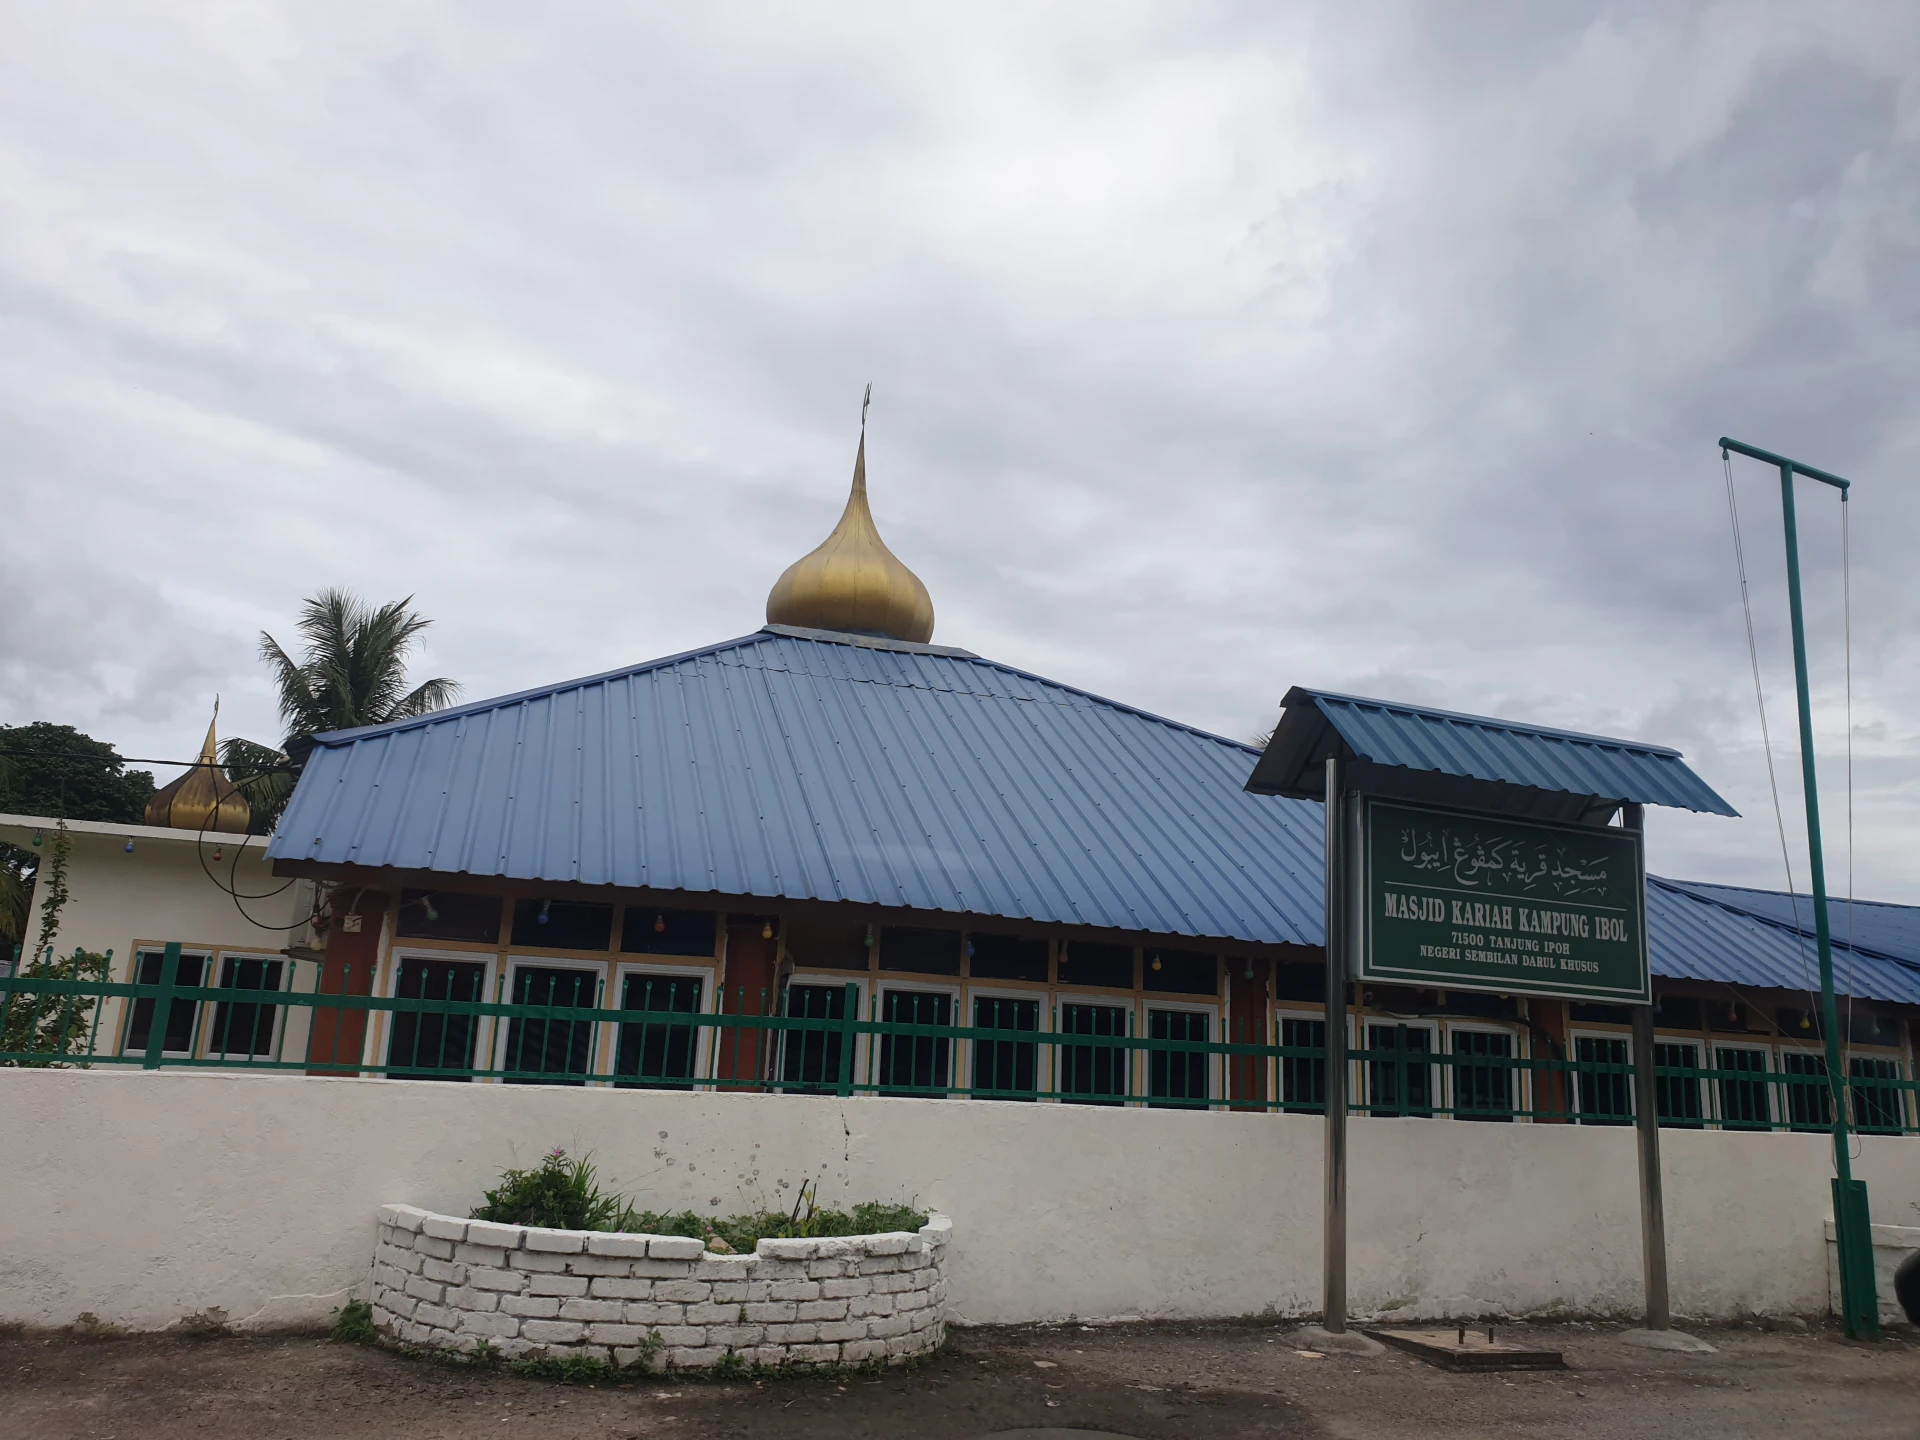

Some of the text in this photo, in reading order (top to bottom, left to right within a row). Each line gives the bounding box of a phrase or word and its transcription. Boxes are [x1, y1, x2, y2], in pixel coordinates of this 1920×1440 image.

[1384, 892, 1628, 942] MASJID KARIAH KAMPUNG IBOL
[1451, 932, 1570, 955] 71500 TANJUNG IPOH
[1420, 944, 1599, 973] NEGERI SEMBILAN DARUL KHUSUS
